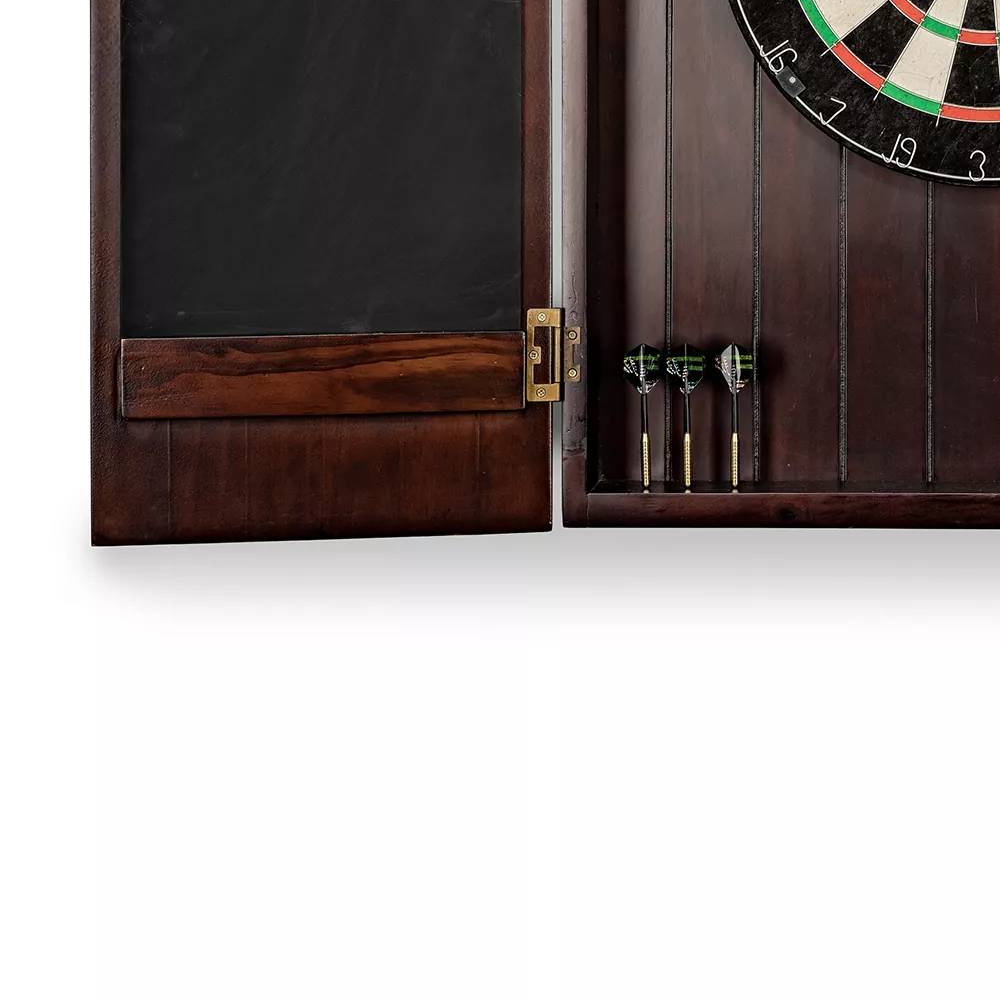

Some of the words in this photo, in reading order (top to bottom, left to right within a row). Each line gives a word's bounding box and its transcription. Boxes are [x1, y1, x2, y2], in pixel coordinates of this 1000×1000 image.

[760, 39, 798, 74] 16
[819, 97, 847, 125] 7
[881, 133, 917, 168] 19
[968, 149, 987, 183] 3
